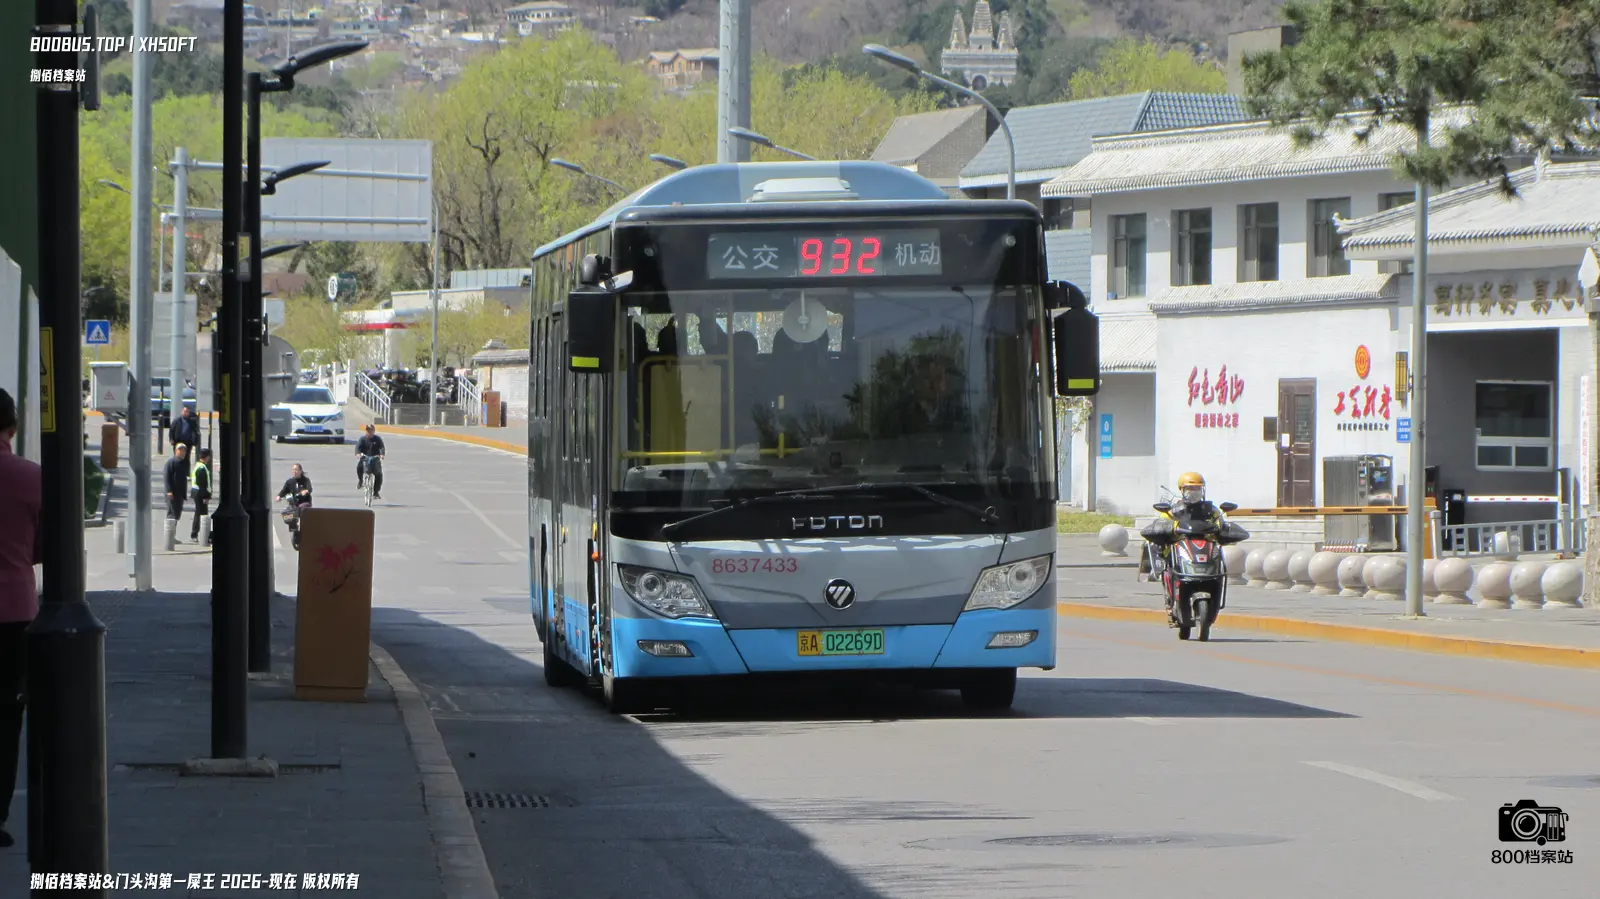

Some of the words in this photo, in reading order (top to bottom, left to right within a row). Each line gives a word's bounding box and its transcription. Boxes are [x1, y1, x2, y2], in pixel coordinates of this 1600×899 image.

[722, 244, 779, 271] 公交
[801, 237, 881, 275] 932
[895, 242, 941, 267] 机动
[791, 515, 883, 530] FOTON
[712, 558, 798, 573] 8637433
[799, 634, 819, 652] 京A
[825, 632, 882, 651] 02269D
